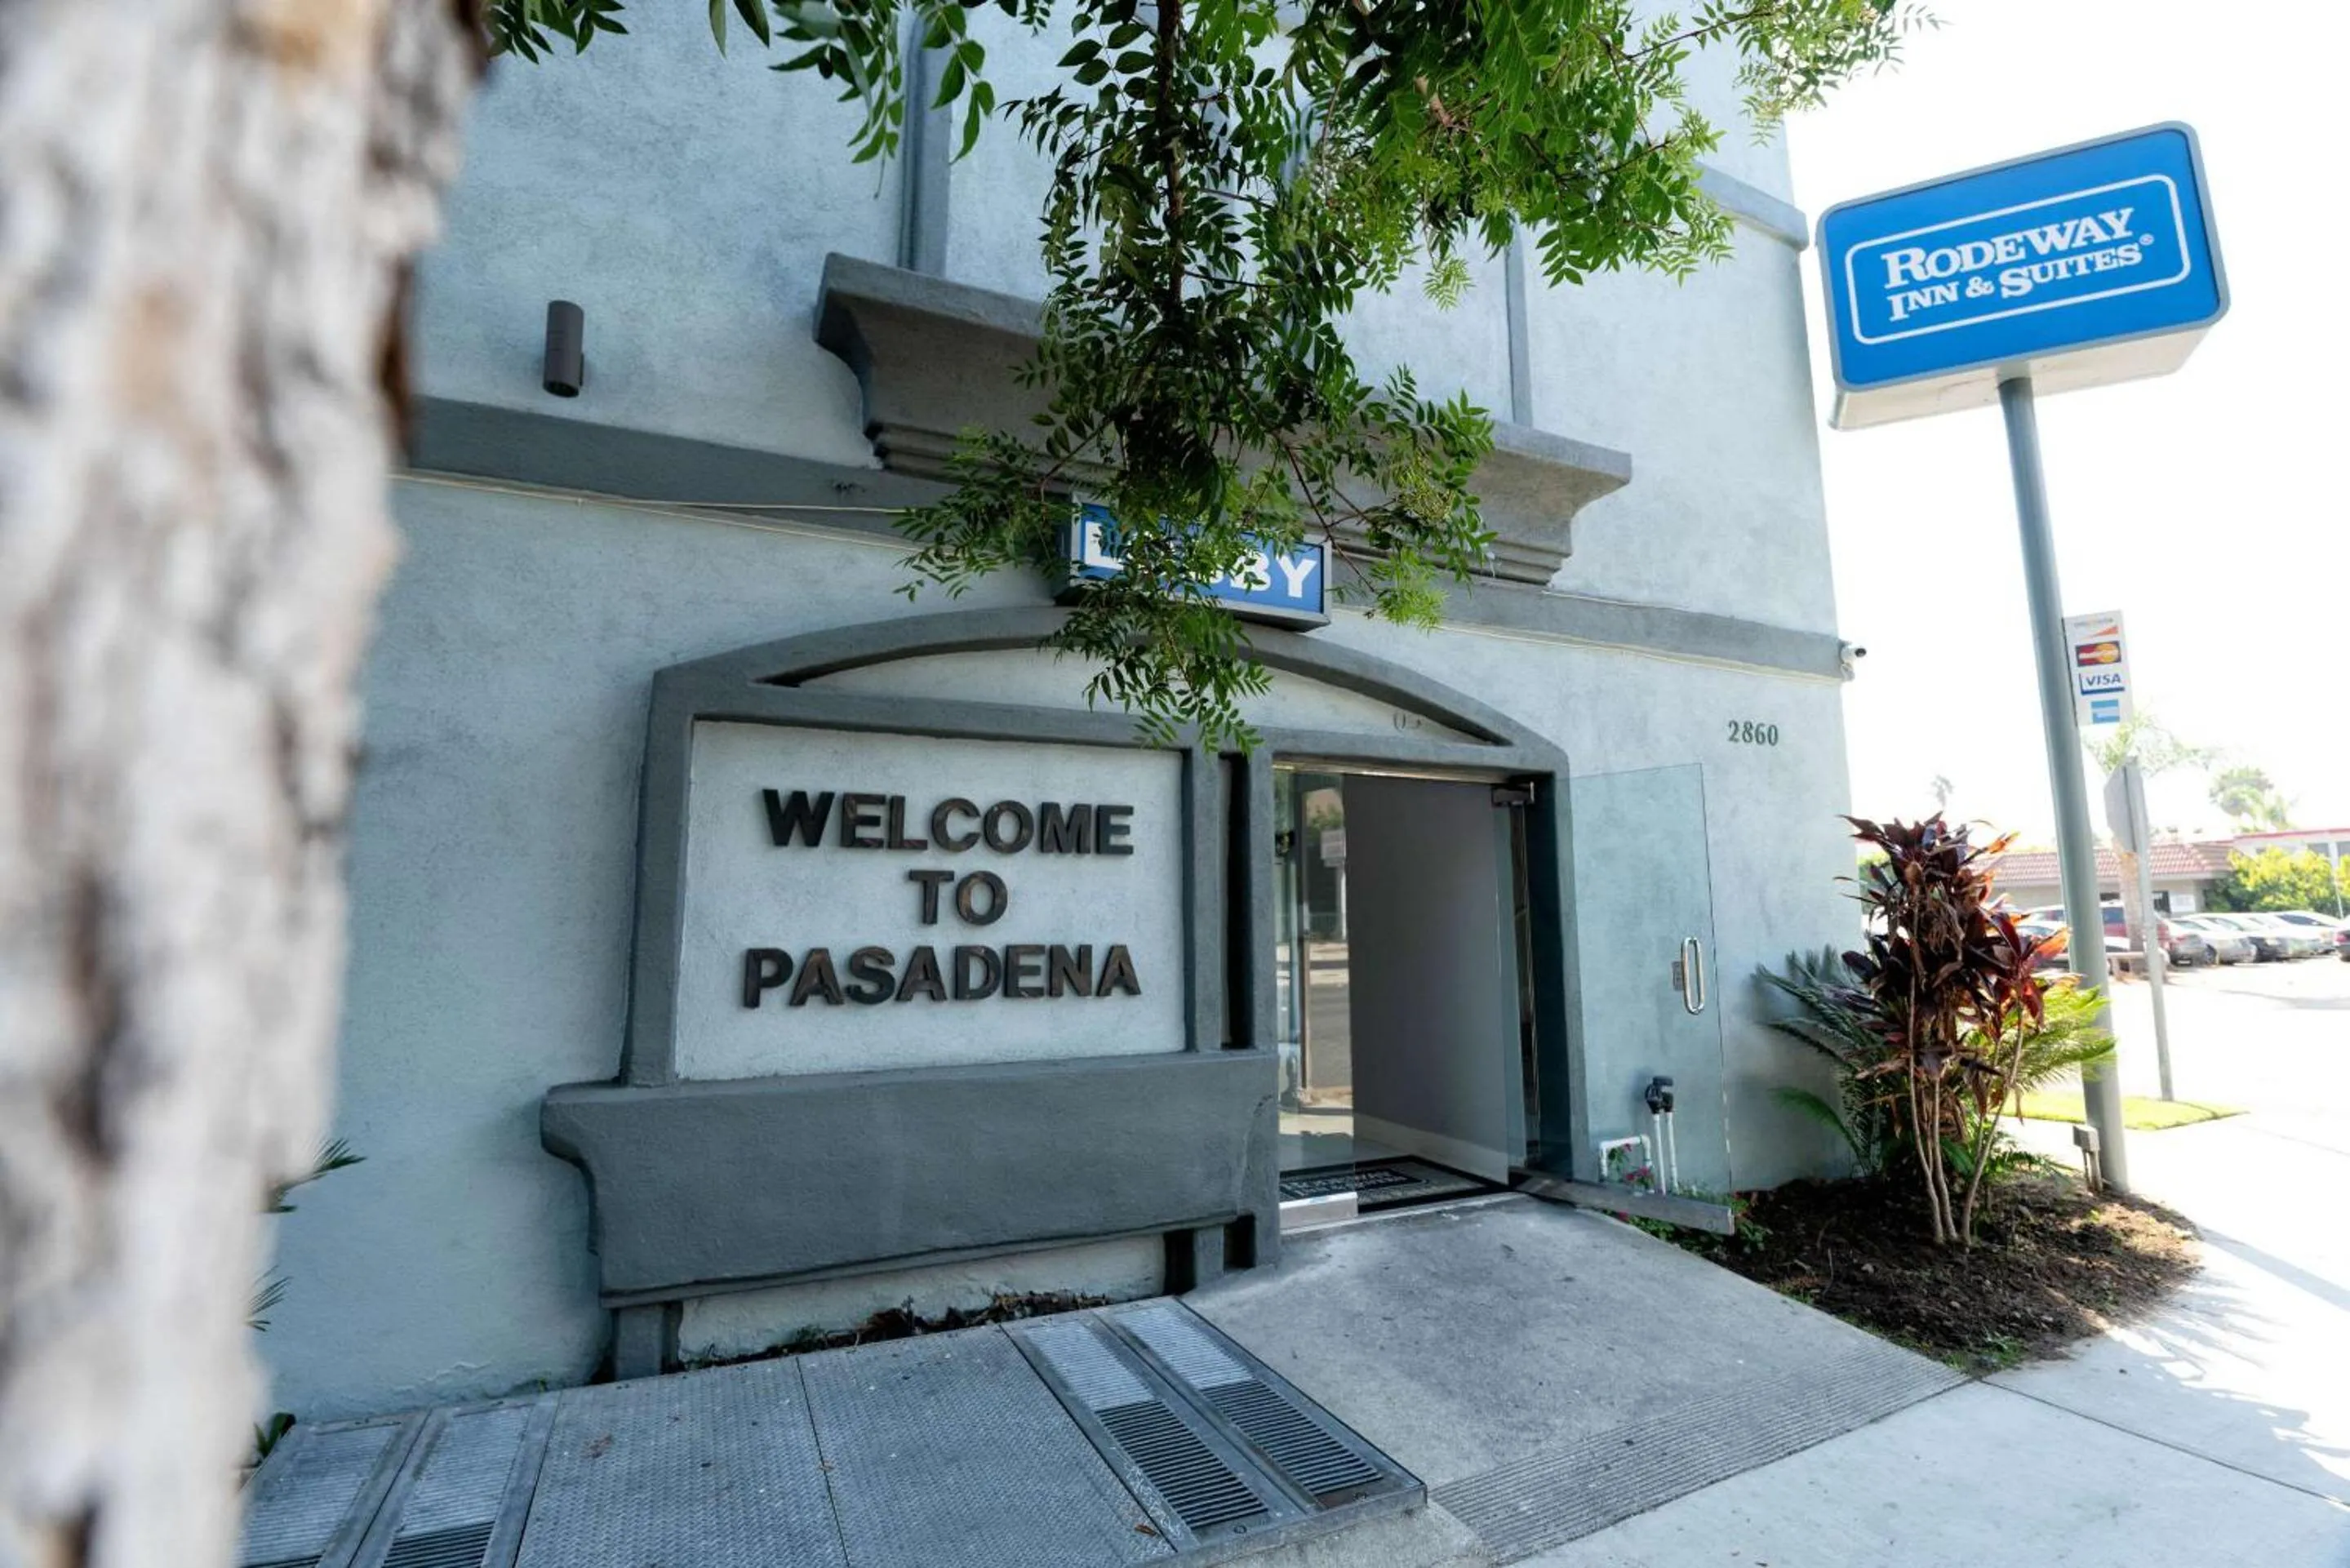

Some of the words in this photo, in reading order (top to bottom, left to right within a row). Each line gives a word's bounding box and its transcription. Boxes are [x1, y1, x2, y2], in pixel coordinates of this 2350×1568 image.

[1881, 207, 2135, 289] RODEWAY
[1886, 281, 1960, 322] INN
[1965, 276, 1995, 298] &
[1998, 242, 2143, 298] SUITES
[1084, 520, 1317, 598] LBY
[2086, 673, 2121, 686] VISA
[1726, 719, 1779, 747] 2860
[762, 788, 1135, 855] WELCOME
[908, 869, 1009, 926] TO
[743, 944, 1142, 1010] PASADENA
